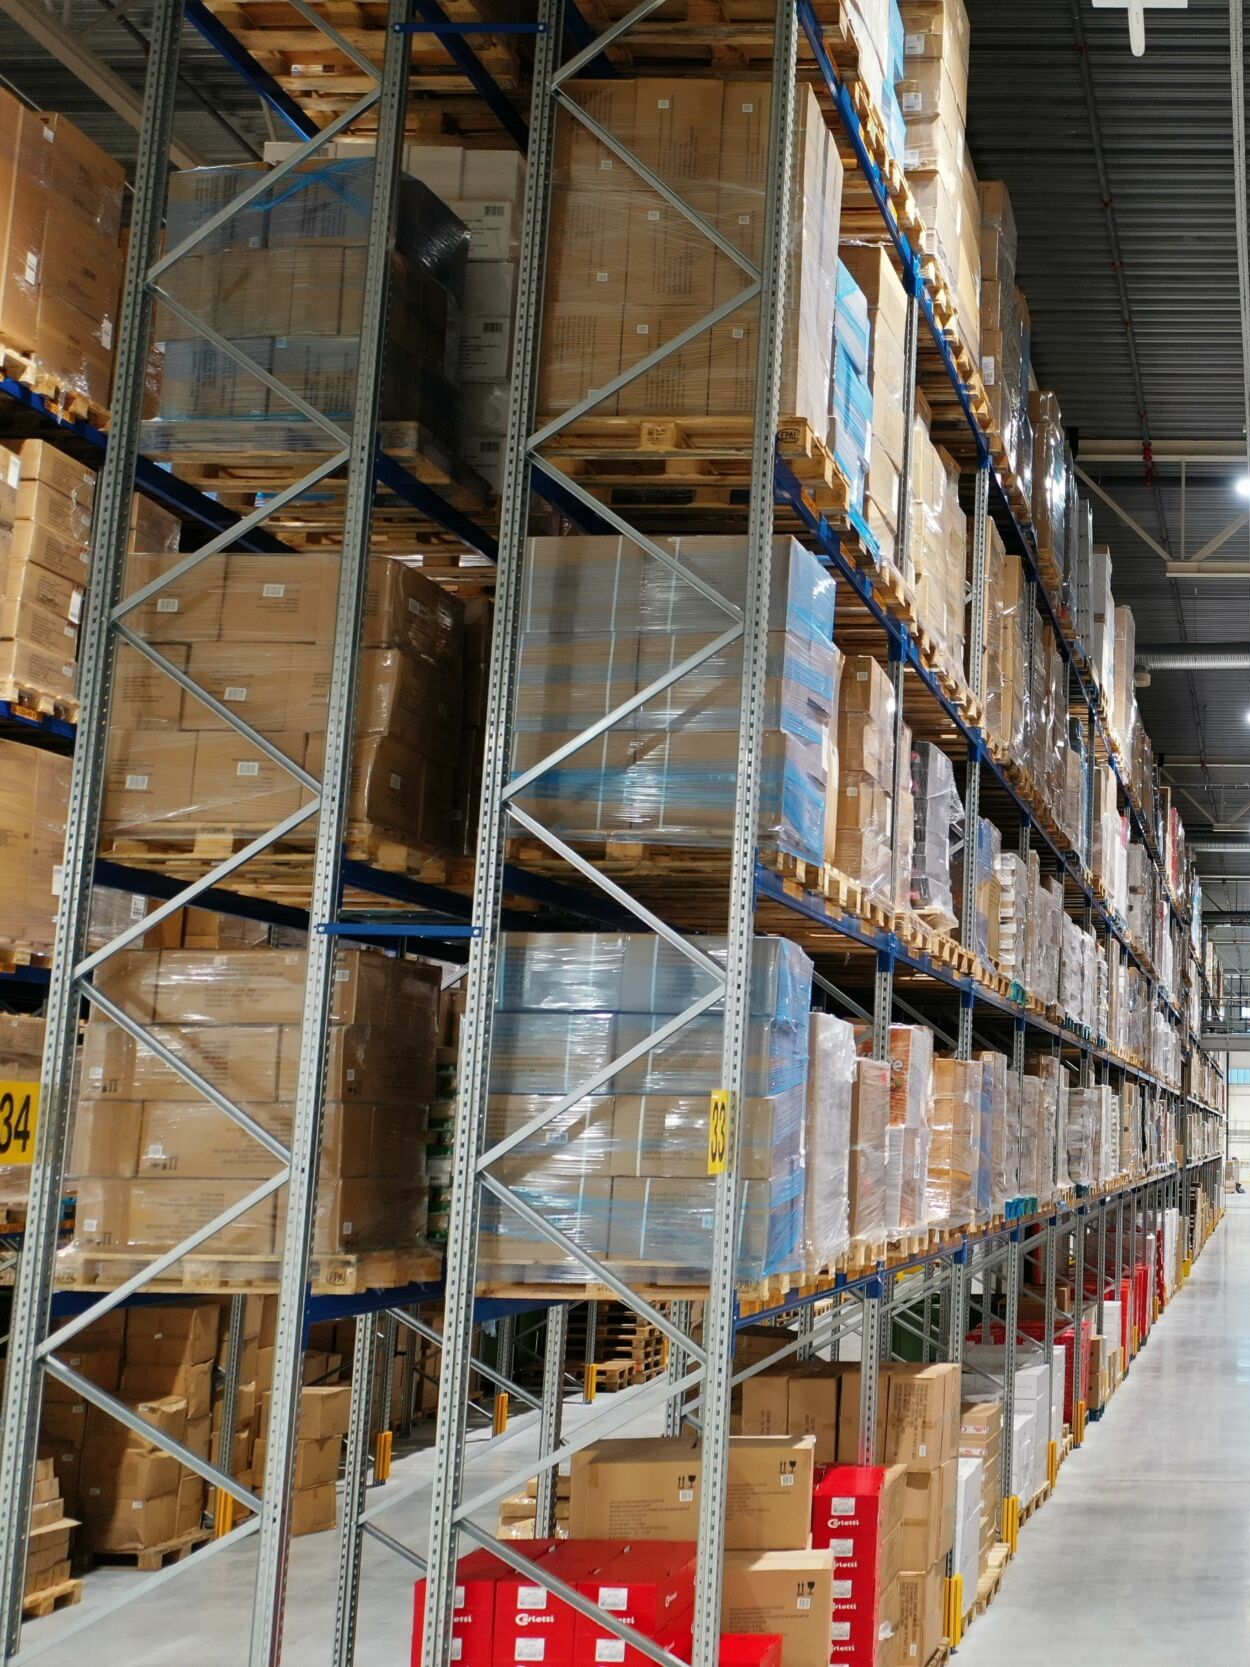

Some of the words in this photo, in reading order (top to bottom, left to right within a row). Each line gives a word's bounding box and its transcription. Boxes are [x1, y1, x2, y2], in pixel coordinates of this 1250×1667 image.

[780, 431, 797, 440] EPAL
[0, 1092, 31, 1154] 34
[711, 1101, 726, 1163] 33
[832, 1561, 858, 1569] rletti
[515, 1613, 555, 1627] Carletti
